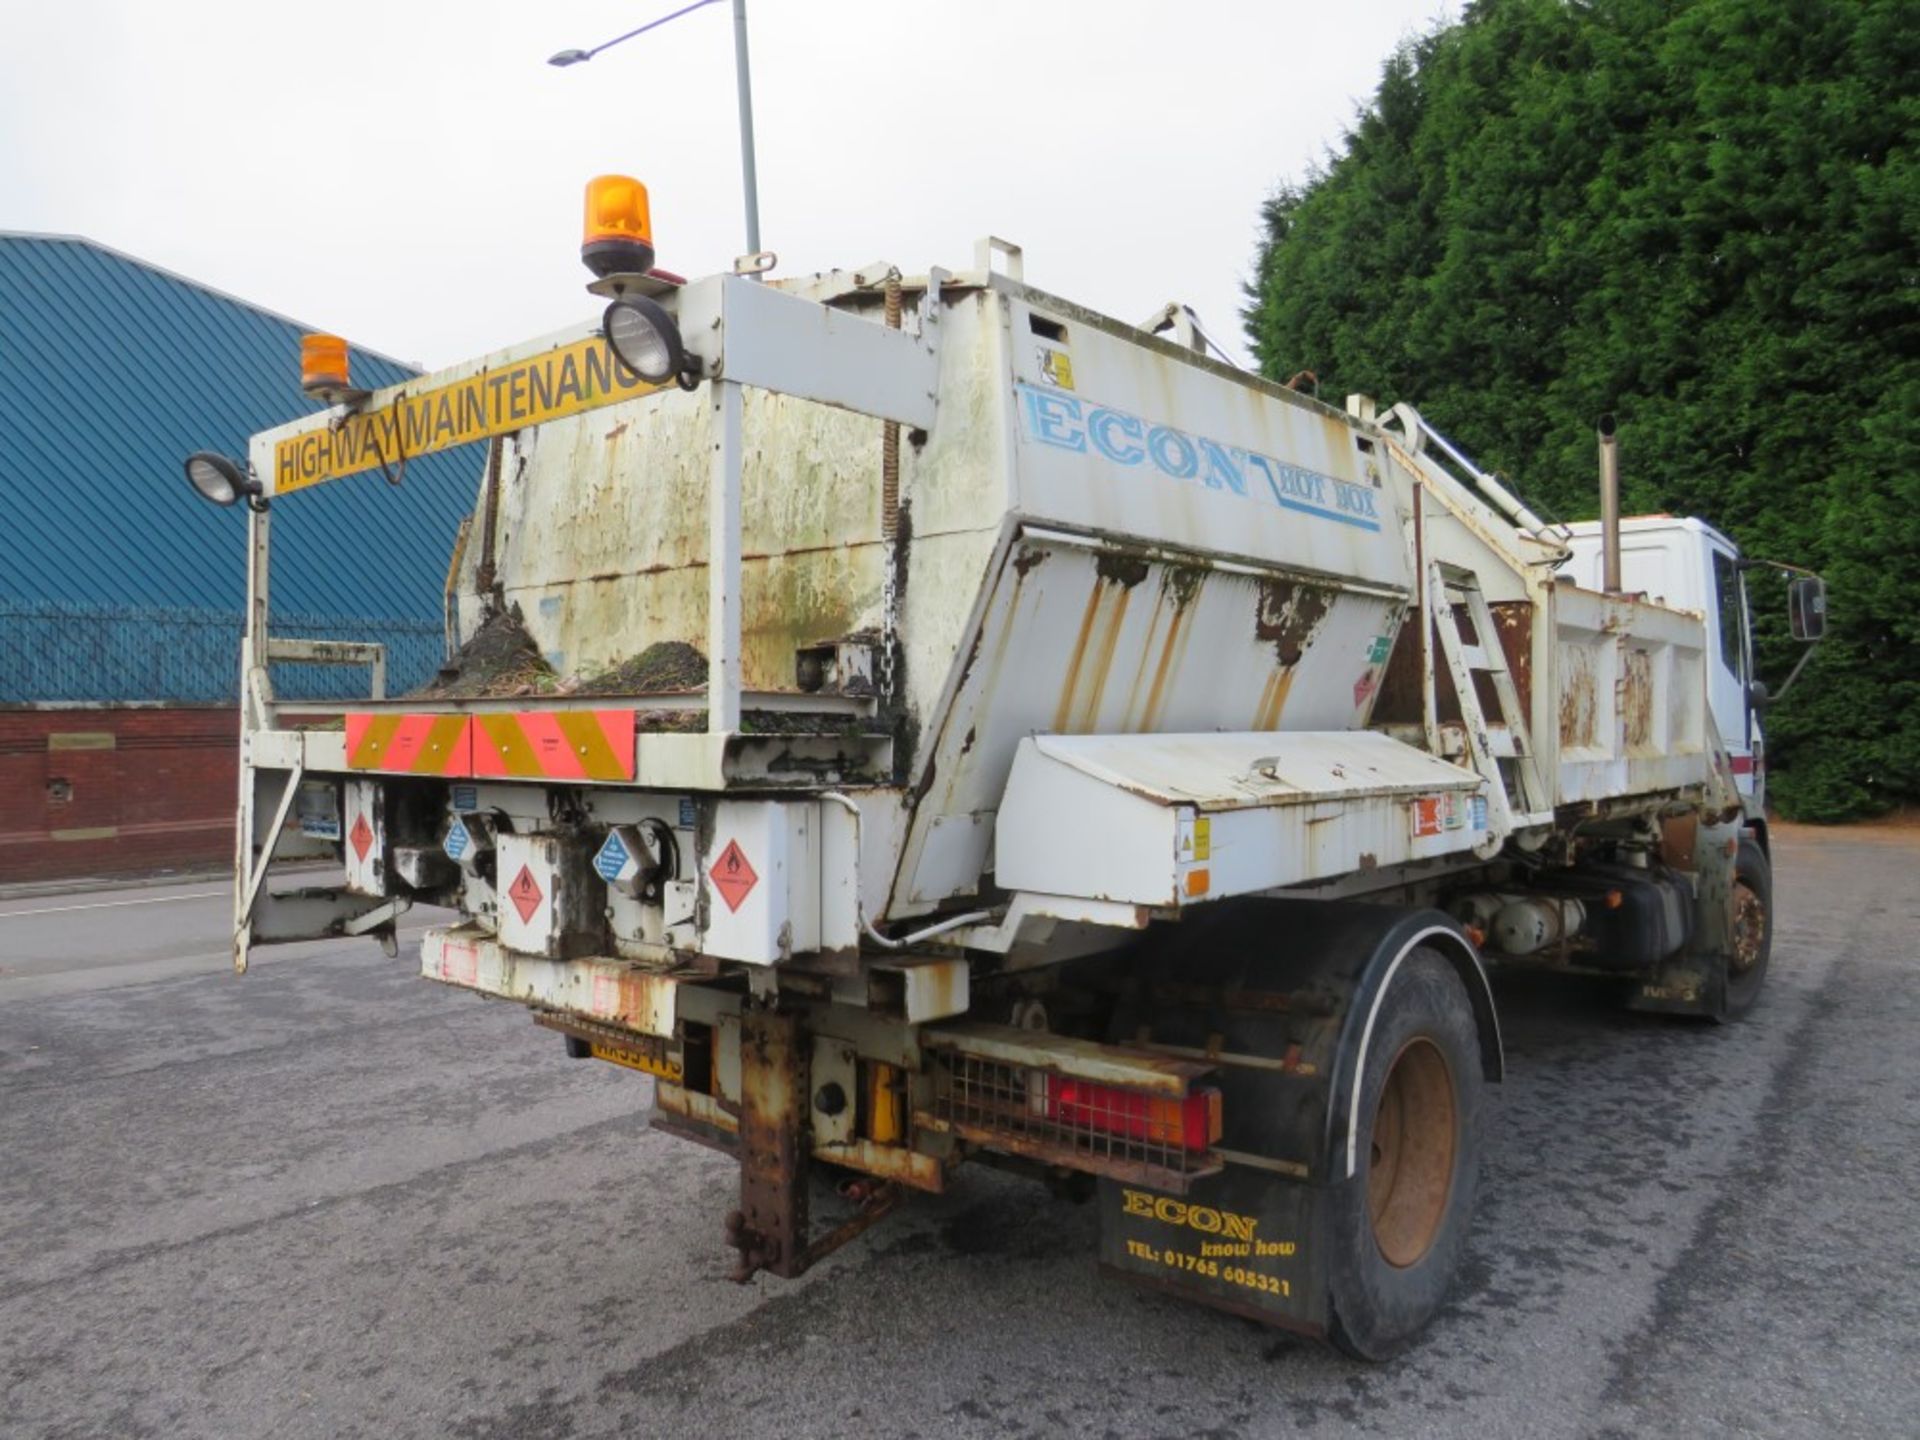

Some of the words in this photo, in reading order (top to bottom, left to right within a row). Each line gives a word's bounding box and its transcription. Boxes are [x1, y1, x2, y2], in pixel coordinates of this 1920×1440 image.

[279, 414, 398, 485] HIGHWAY
[404, 342, 640, 451] MAINTENANC
[1023, 385, 1252, 497] ECON
[1122, 1189, 1258, 1241] ECON
[1126, 1239, 1160, 1263] TEL:
[1163, 1250, 1219, 1277] 01765
[1222, 1265, 1291, 1297] 605321
[1201, 1239, 1251, 1258] know
[1254, 1237, 1296, 1257] how
